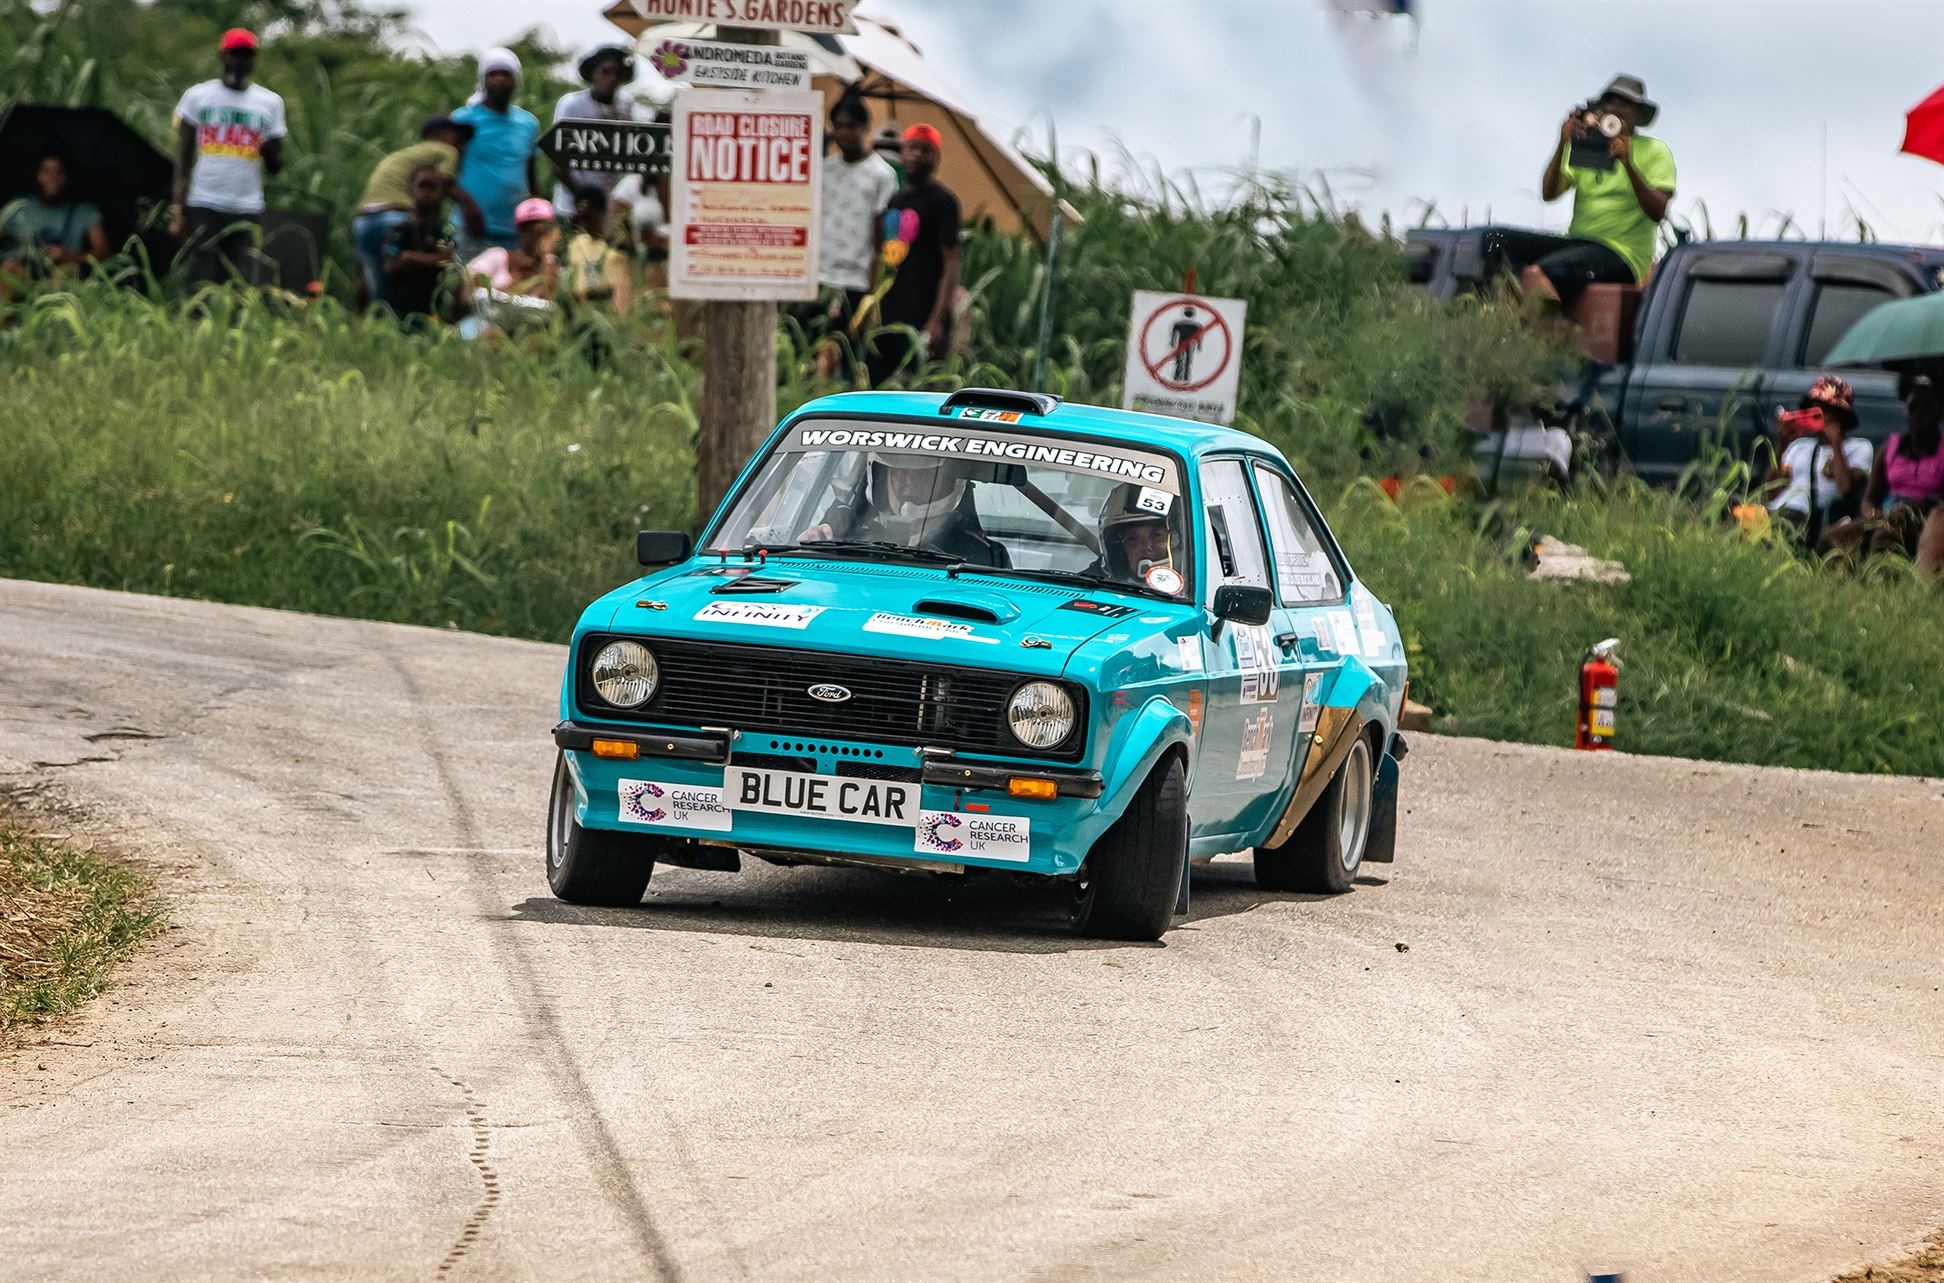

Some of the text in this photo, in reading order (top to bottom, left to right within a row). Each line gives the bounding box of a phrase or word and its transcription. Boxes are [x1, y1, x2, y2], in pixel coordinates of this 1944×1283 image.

[743, 0, 845, 27] GARDENS
[684, 46, 774, 65] ANDROMEDA
[694, 65, 801, 86] EASTSIDE KITCHEN
[690, 136, 809, 182] NOTICE
[801, 431, 1165, 484] WORSWICK ENGINEERING
[1142, 498, 1166, 511] 53
[817, 686, 842, 698] Ford
[671, 790, 718, 803] CANCER
[740, 772, 906, 820] BLUE CAR
[673, 801, 731, 813] RESEARCH
[673, 811, 689, 821] UK
[969, 820, 1016, 833] CANCER
[970, 831, 1029, 844] RESEARCH
[970, 841, 986, 851] UK
